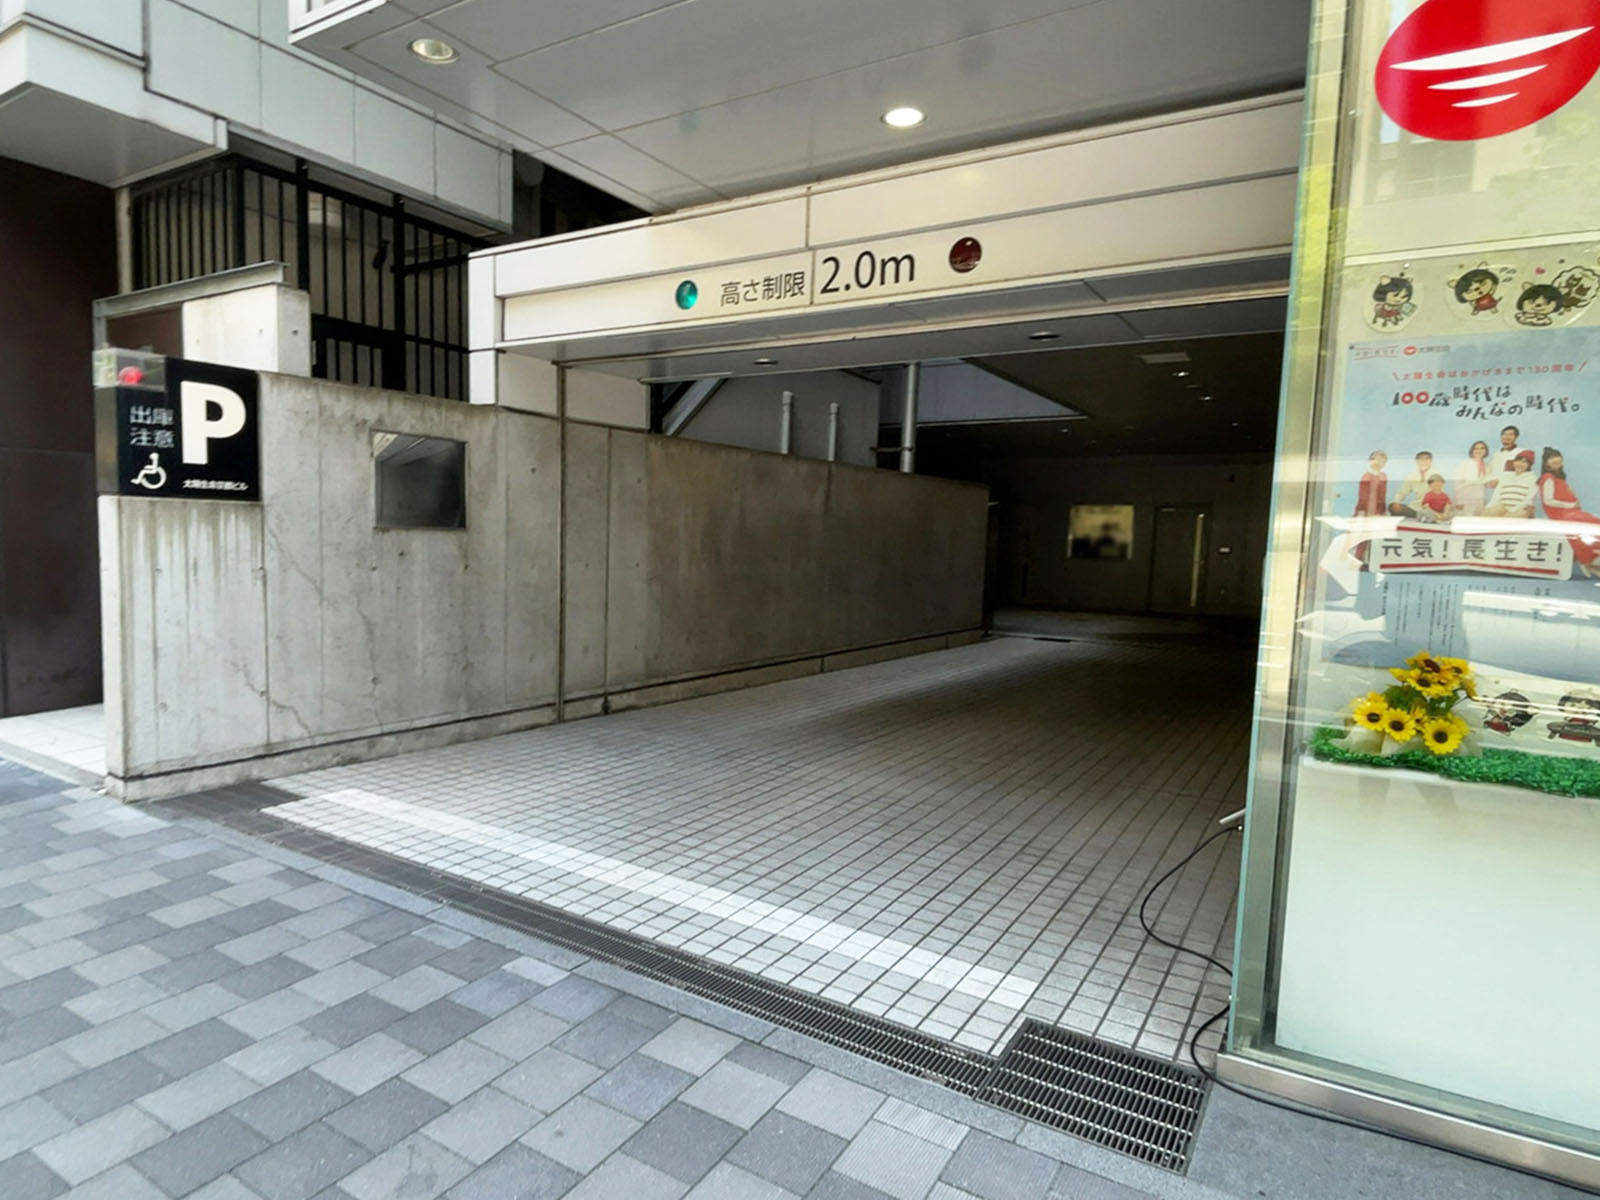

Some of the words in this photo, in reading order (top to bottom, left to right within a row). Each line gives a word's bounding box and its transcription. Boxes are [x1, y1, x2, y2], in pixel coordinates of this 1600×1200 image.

[720, 271, 806, 307] 高さ制限
[820, 250, 916, 295] 2.0m
[1391, 385, 1513, 408] 100歳時代は
[1455, 395, 1581, 421] みんなの時代。
[129, 405, 174, 426] 出庫
[180, 380, 247, 465] P
[129, 427, 174, 448] 注意
